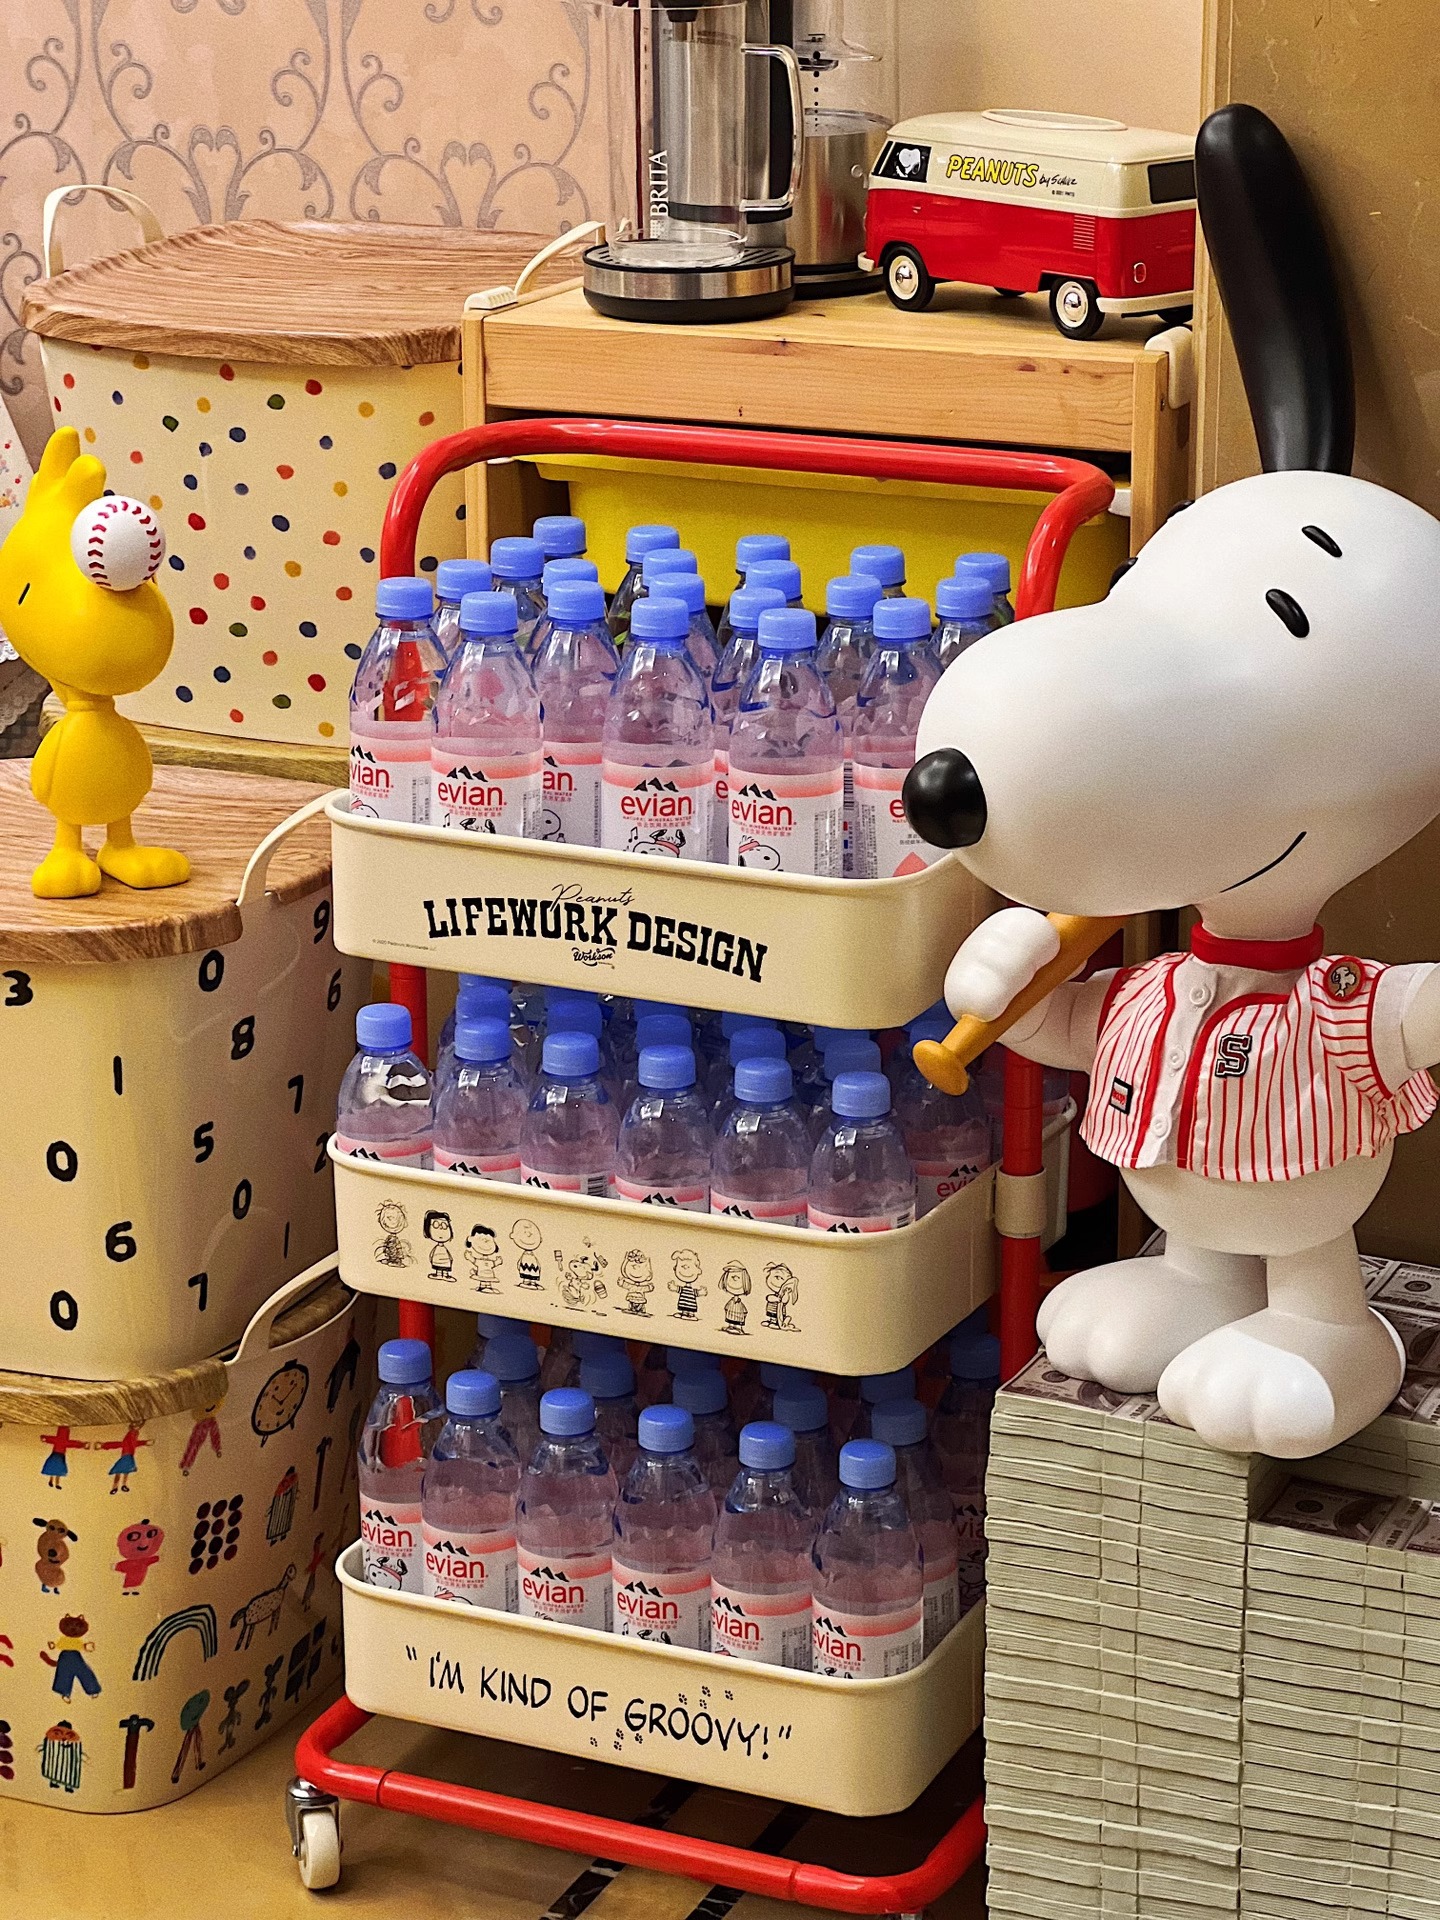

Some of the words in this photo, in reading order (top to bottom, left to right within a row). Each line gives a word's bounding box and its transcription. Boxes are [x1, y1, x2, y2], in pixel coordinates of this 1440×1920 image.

[648, 150, 669, 217] BRITA
[946, 154, 1039, 188] PEANUTS
[350, 760, 390, 788] vian
[438, 781, 503, 806] evian
[621, 793, 692, 816] evian
[732, 800, 792, 825] evian
[551, 884, 635, 912] Peanuts
[314, 900, 330, 944] 9
[423, 897, 618, 946] LIFEWORK
[626, 910, 768, 982] DESIGN
[3, 970, 33, 1006] 3
[199, 949, 224, 992] 0
[327, 968, 341, 1012] 6
[231, 1015, 255, 1060] 8
[1215, 1034, 1251, 1078] S
[288, 1075, 304, 1114] 7
[47, 1141, 77, 1181] 0
[194, 1121, 214, 1163] 5
[314, 1132, 330, 1173] 2
[233, 1179, 252, 1220] 0
[936, 1176, 976, 1197] evi
[106, 1221, 136, 1262] 6
[50, 1291, 78, 1330] 0
[188, 1273, 208, 1311] 7
[362, 1520, 413, 1547] evian
[426, 1552, 484, 1578] evian
[523, 1577, 584, 1603] evian
[617, 1592, 678, 1619] evian
[480, 1666, 552, 1709] KIND
[567, 1685, 609, 1722] OF
